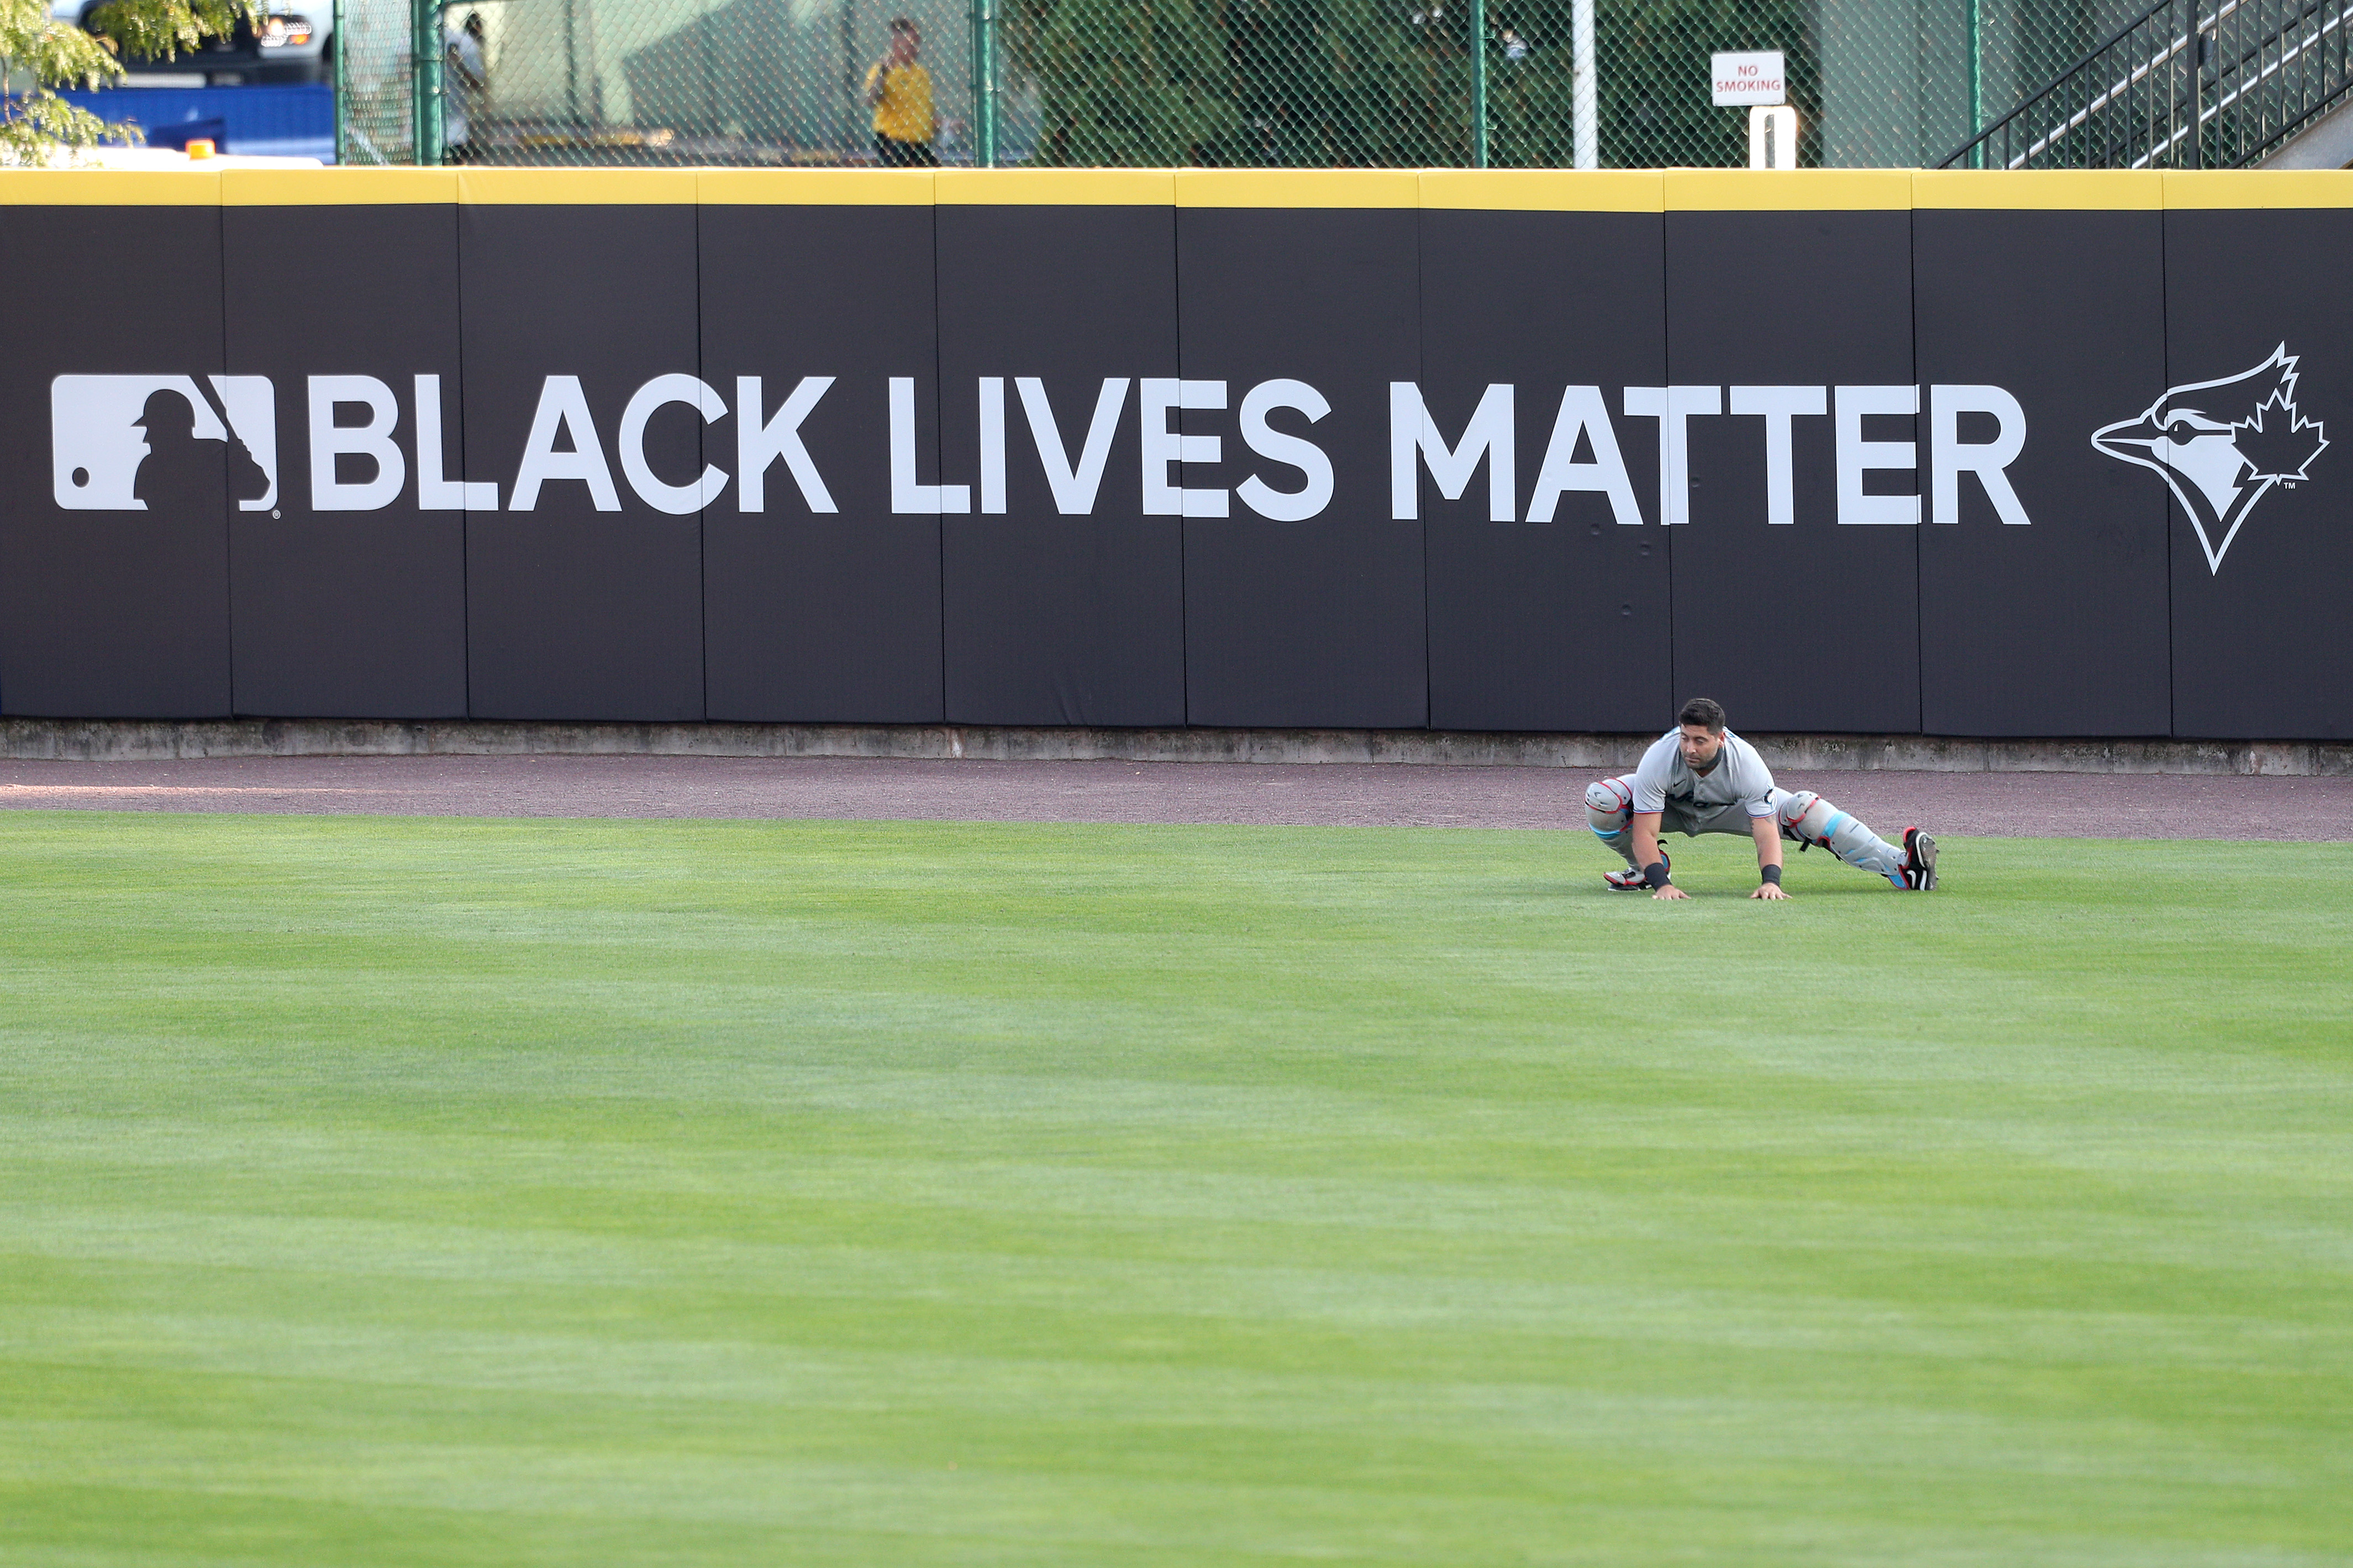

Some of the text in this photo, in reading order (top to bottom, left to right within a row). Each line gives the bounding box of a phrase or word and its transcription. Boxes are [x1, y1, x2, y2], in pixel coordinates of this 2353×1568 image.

[1738, 66, 1758, 76] NO
[1717, 80, 1781, 92] SMOKING
[307, 373, 2032, 526] BLACK LIVES MATTER
